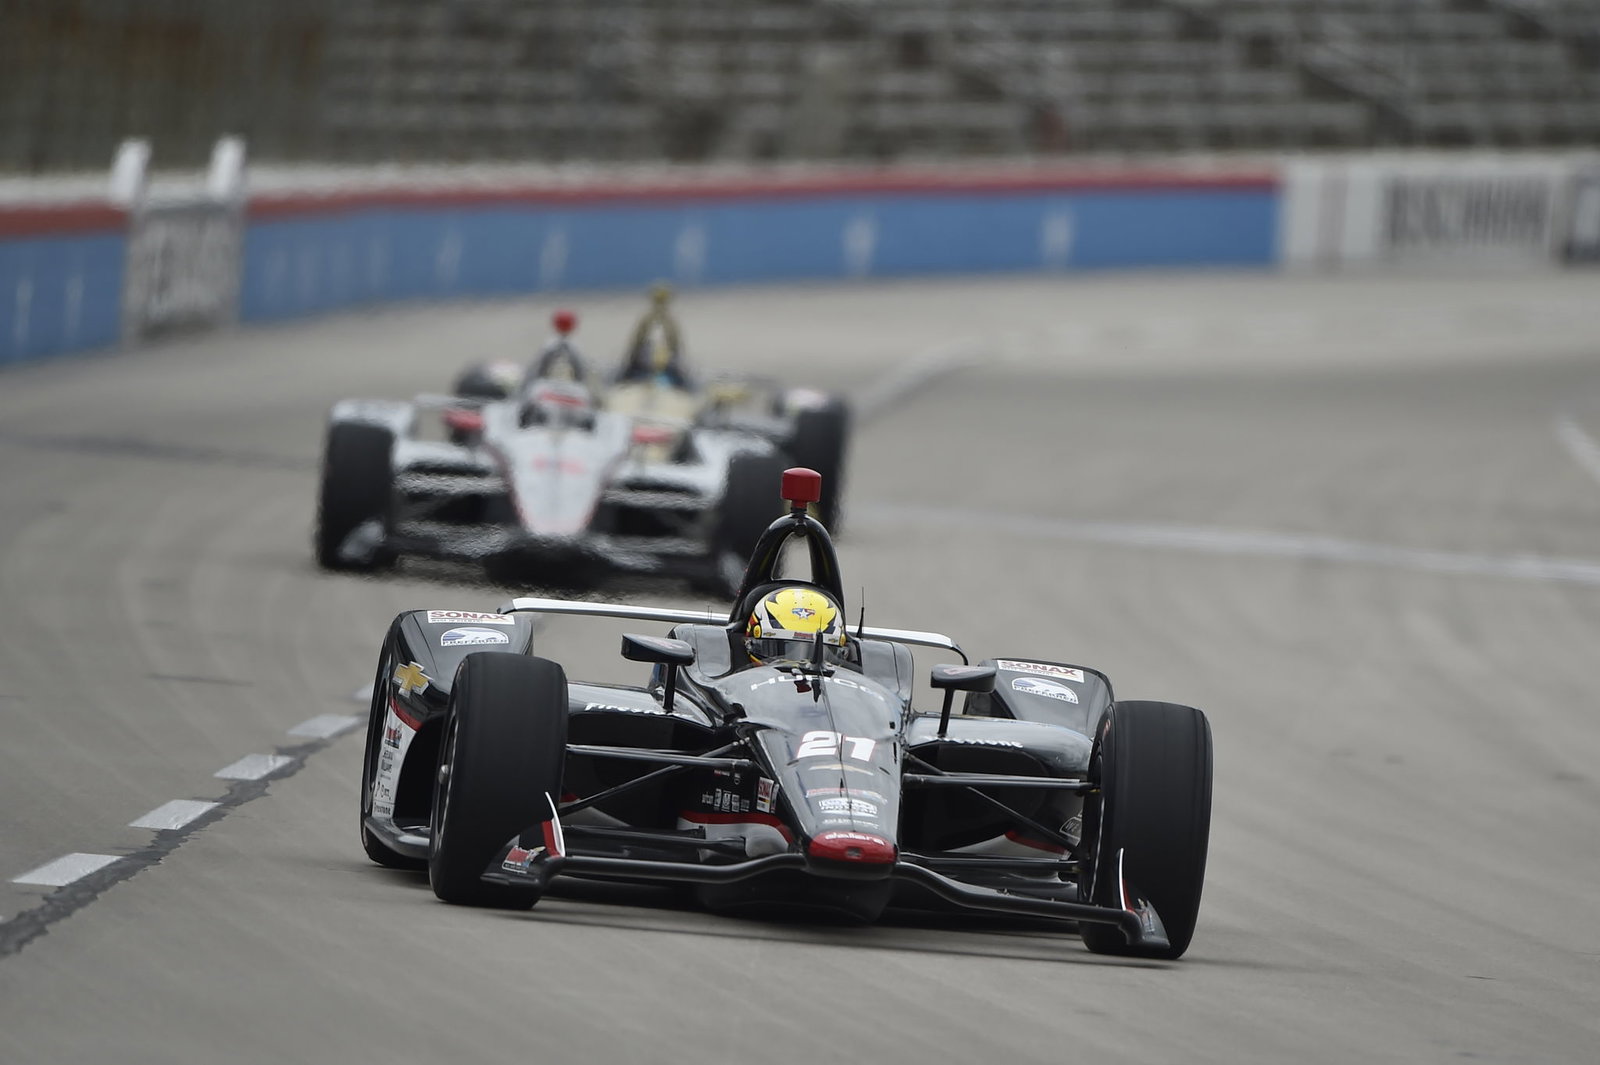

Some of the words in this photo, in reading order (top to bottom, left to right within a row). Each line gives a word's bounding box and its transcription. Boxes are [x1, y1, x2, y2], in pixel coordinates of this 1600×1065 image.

[430, 611, 507, 621] SONAX
[1001, 661, 1077, 676] SONAX
[797, 731, 876, 762] 21
